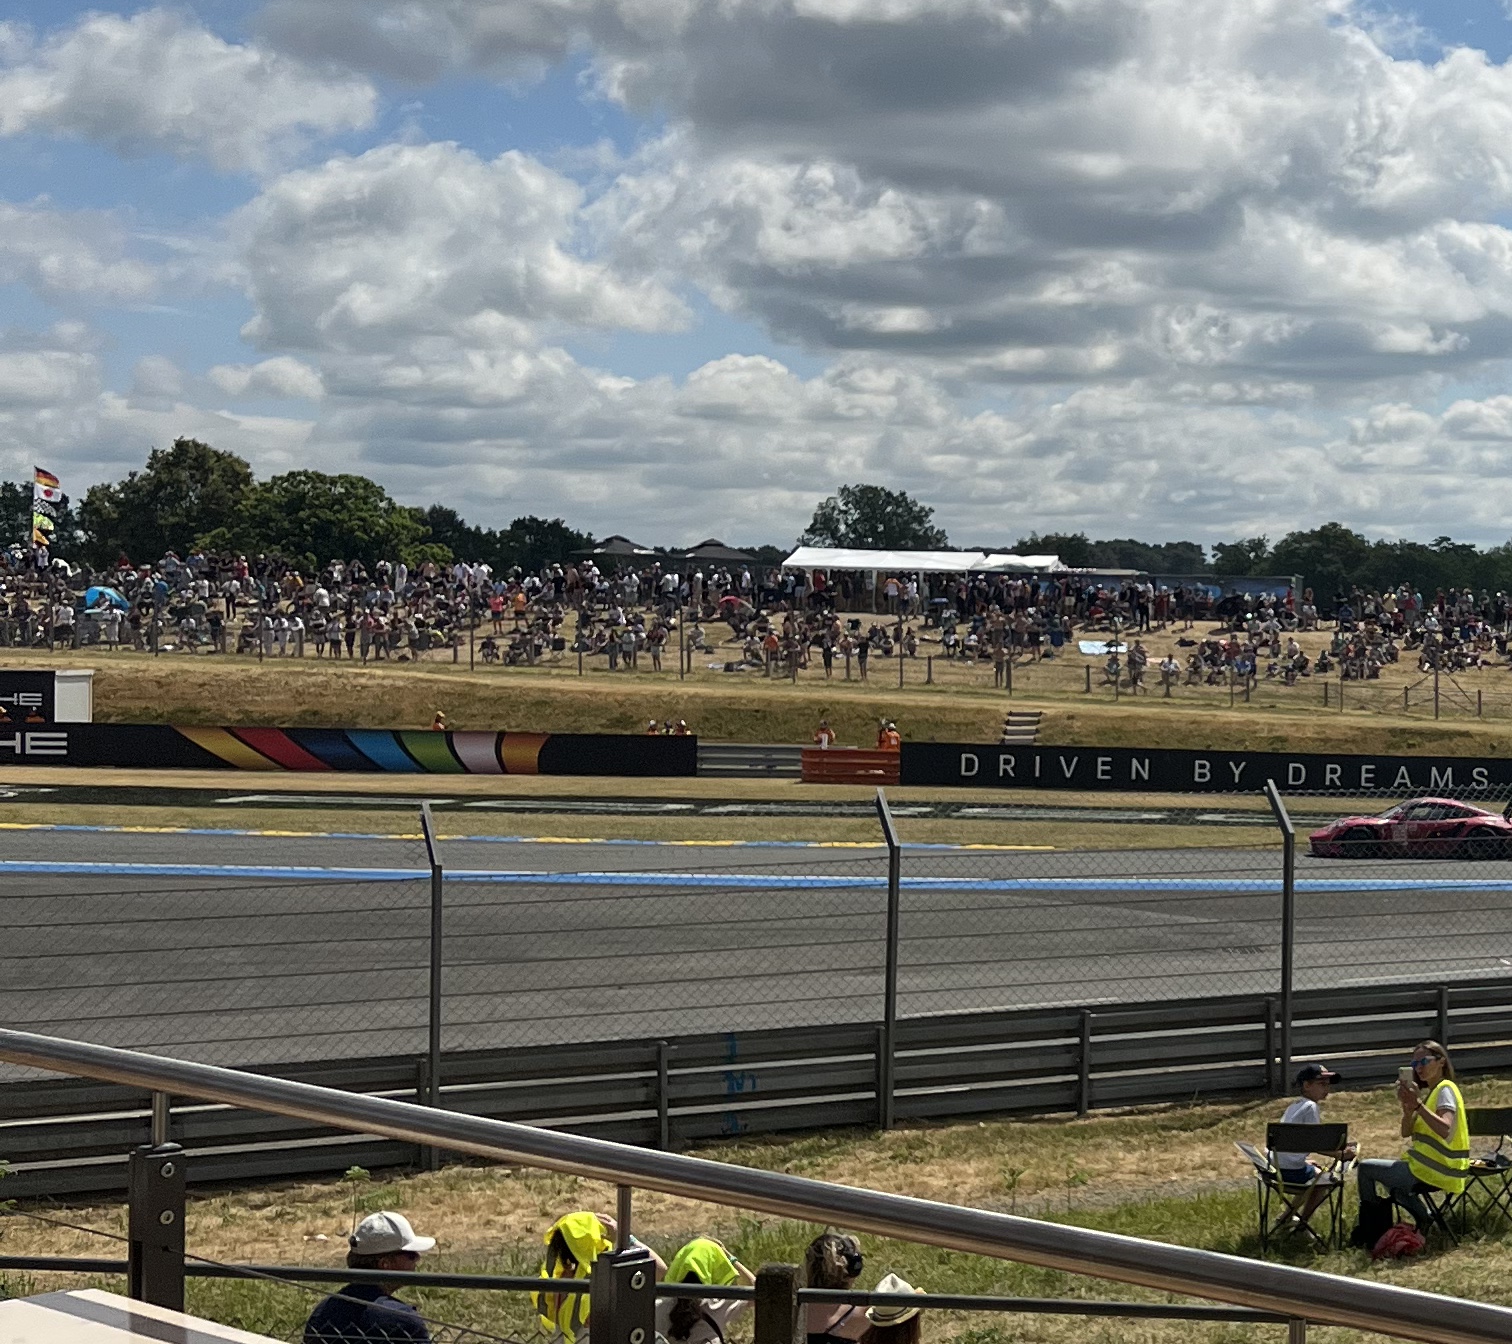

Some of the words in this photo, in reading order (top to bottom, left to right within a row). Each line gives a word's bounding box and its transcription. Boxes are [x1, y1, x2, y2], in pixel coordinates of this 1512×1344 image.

[960, 753, 1150, 781] DRIVEN
[1193, 759, 1247, 784] BY
[1287, 762, 1489, 790] DREAMS
